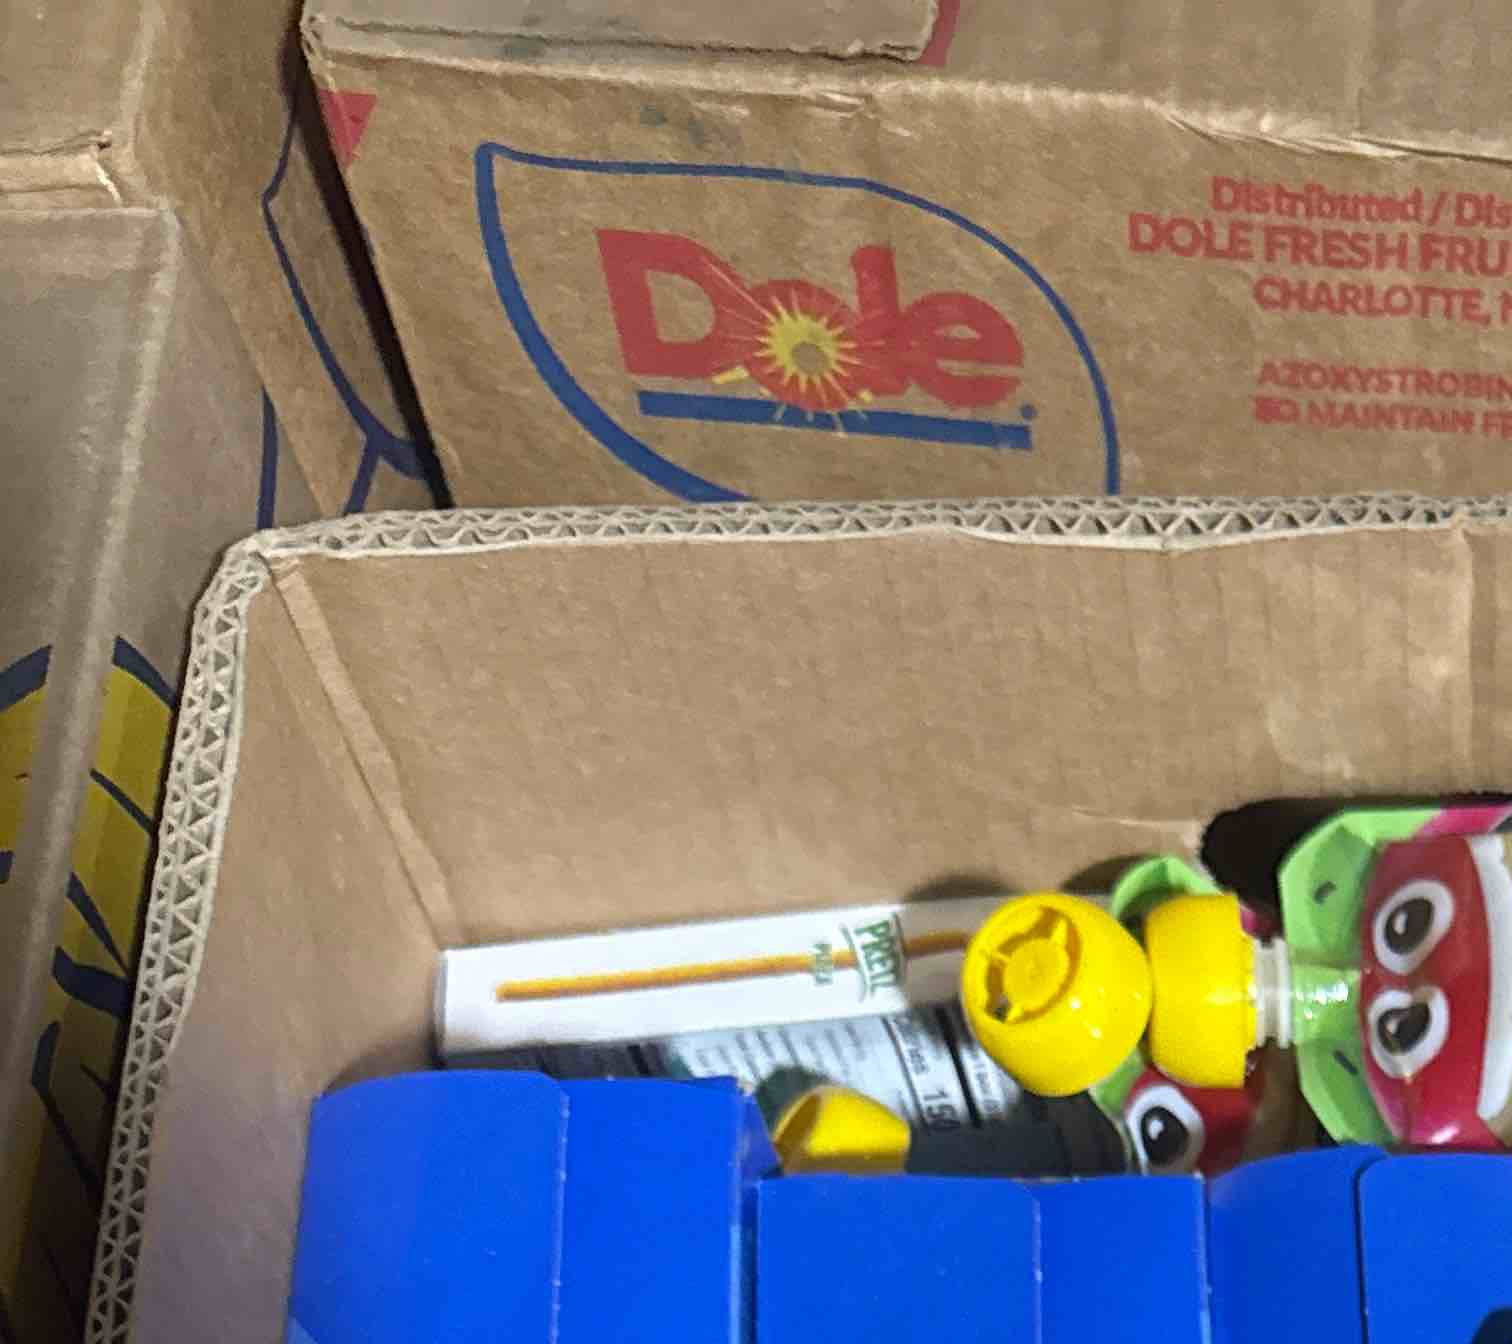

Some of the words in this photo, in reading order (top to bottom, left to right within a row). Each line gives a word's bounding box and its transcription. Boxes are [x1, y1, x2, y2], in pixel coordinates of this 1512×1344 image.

[1211, 175, 1421, 227] Distributed
[1128, 212, 1255, 262] DOLE
[1263, 222, 1410, 273] FRESH
[599, 227, 1025, 412] Dole
[1251, 276, 1492, 329] CHARLOTTE,
